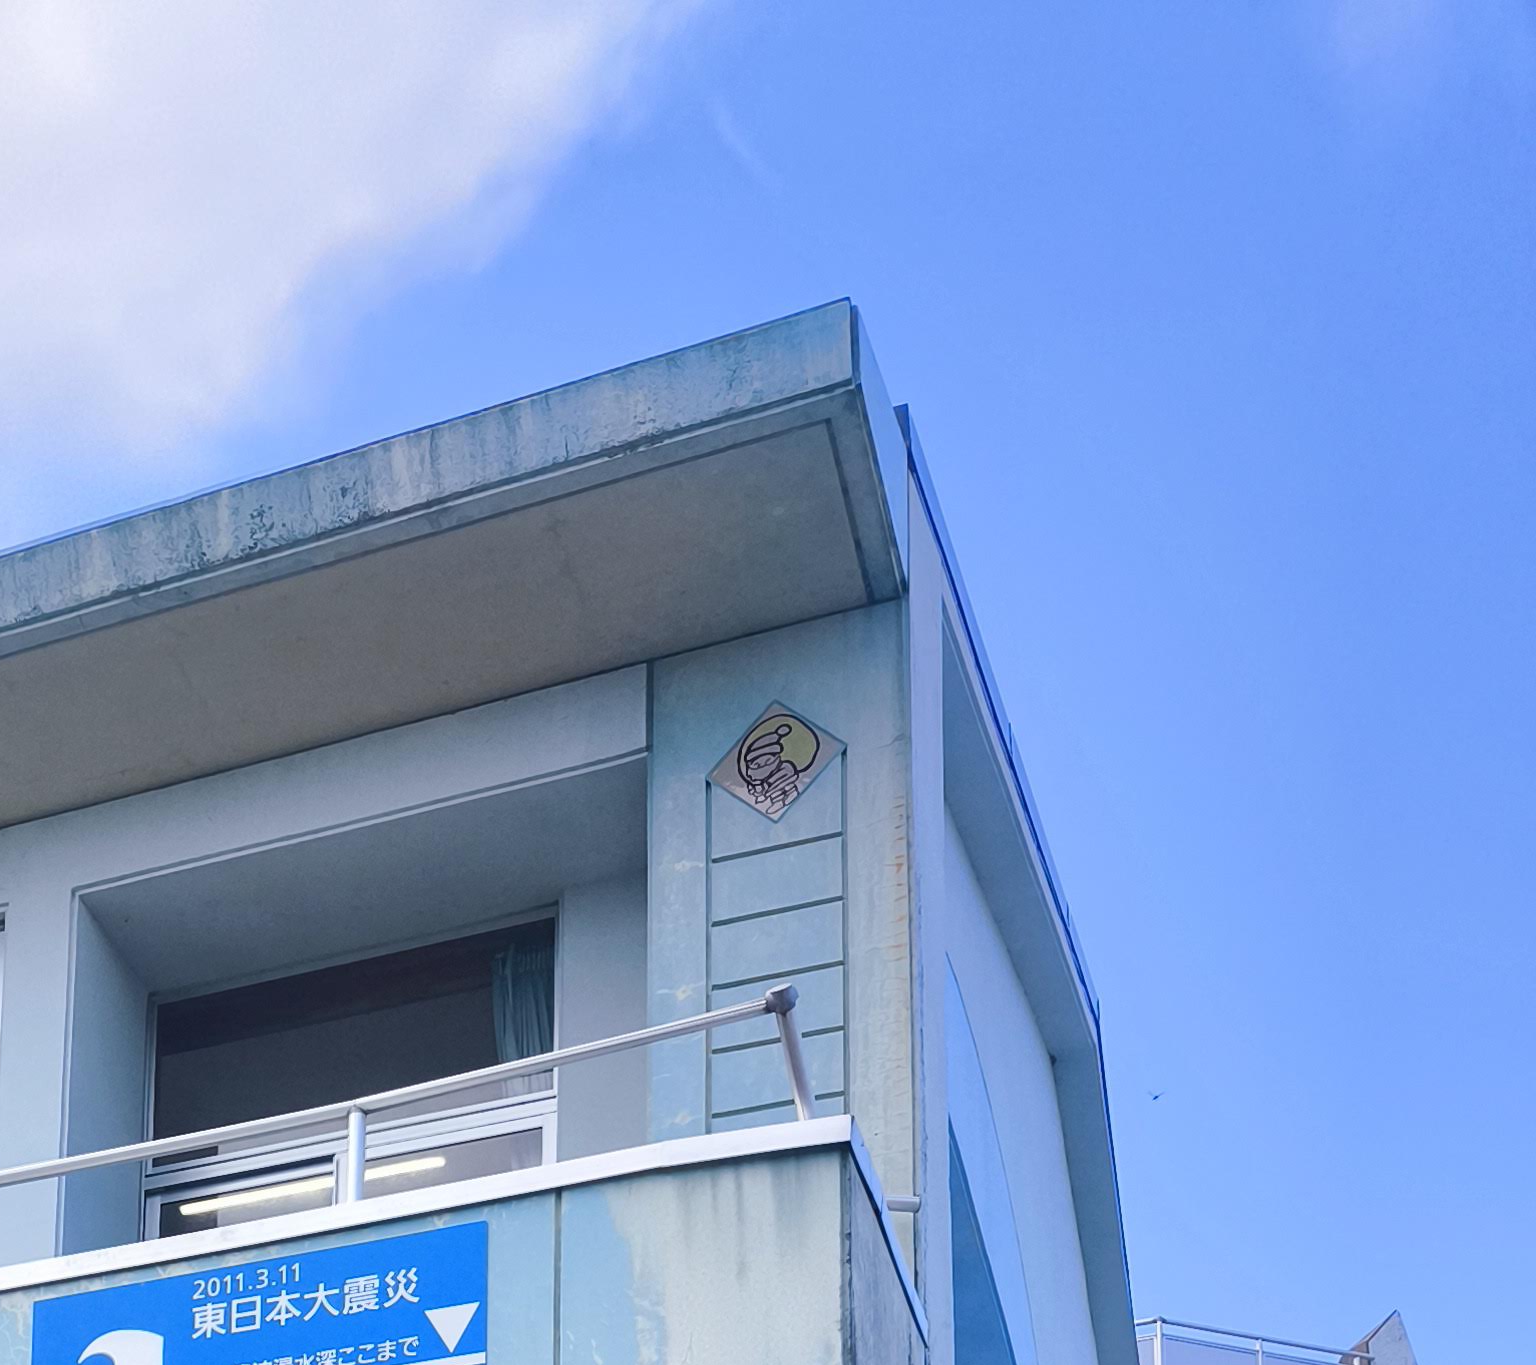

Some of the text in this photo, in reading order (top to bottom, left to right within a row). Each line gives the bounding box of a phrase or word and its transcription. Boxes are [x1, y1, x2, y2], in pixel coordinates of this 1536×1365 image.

[191, 1266, 420, 1340] 東日本大震災
[192, 1262, 301, 1300] 2011.3.11
